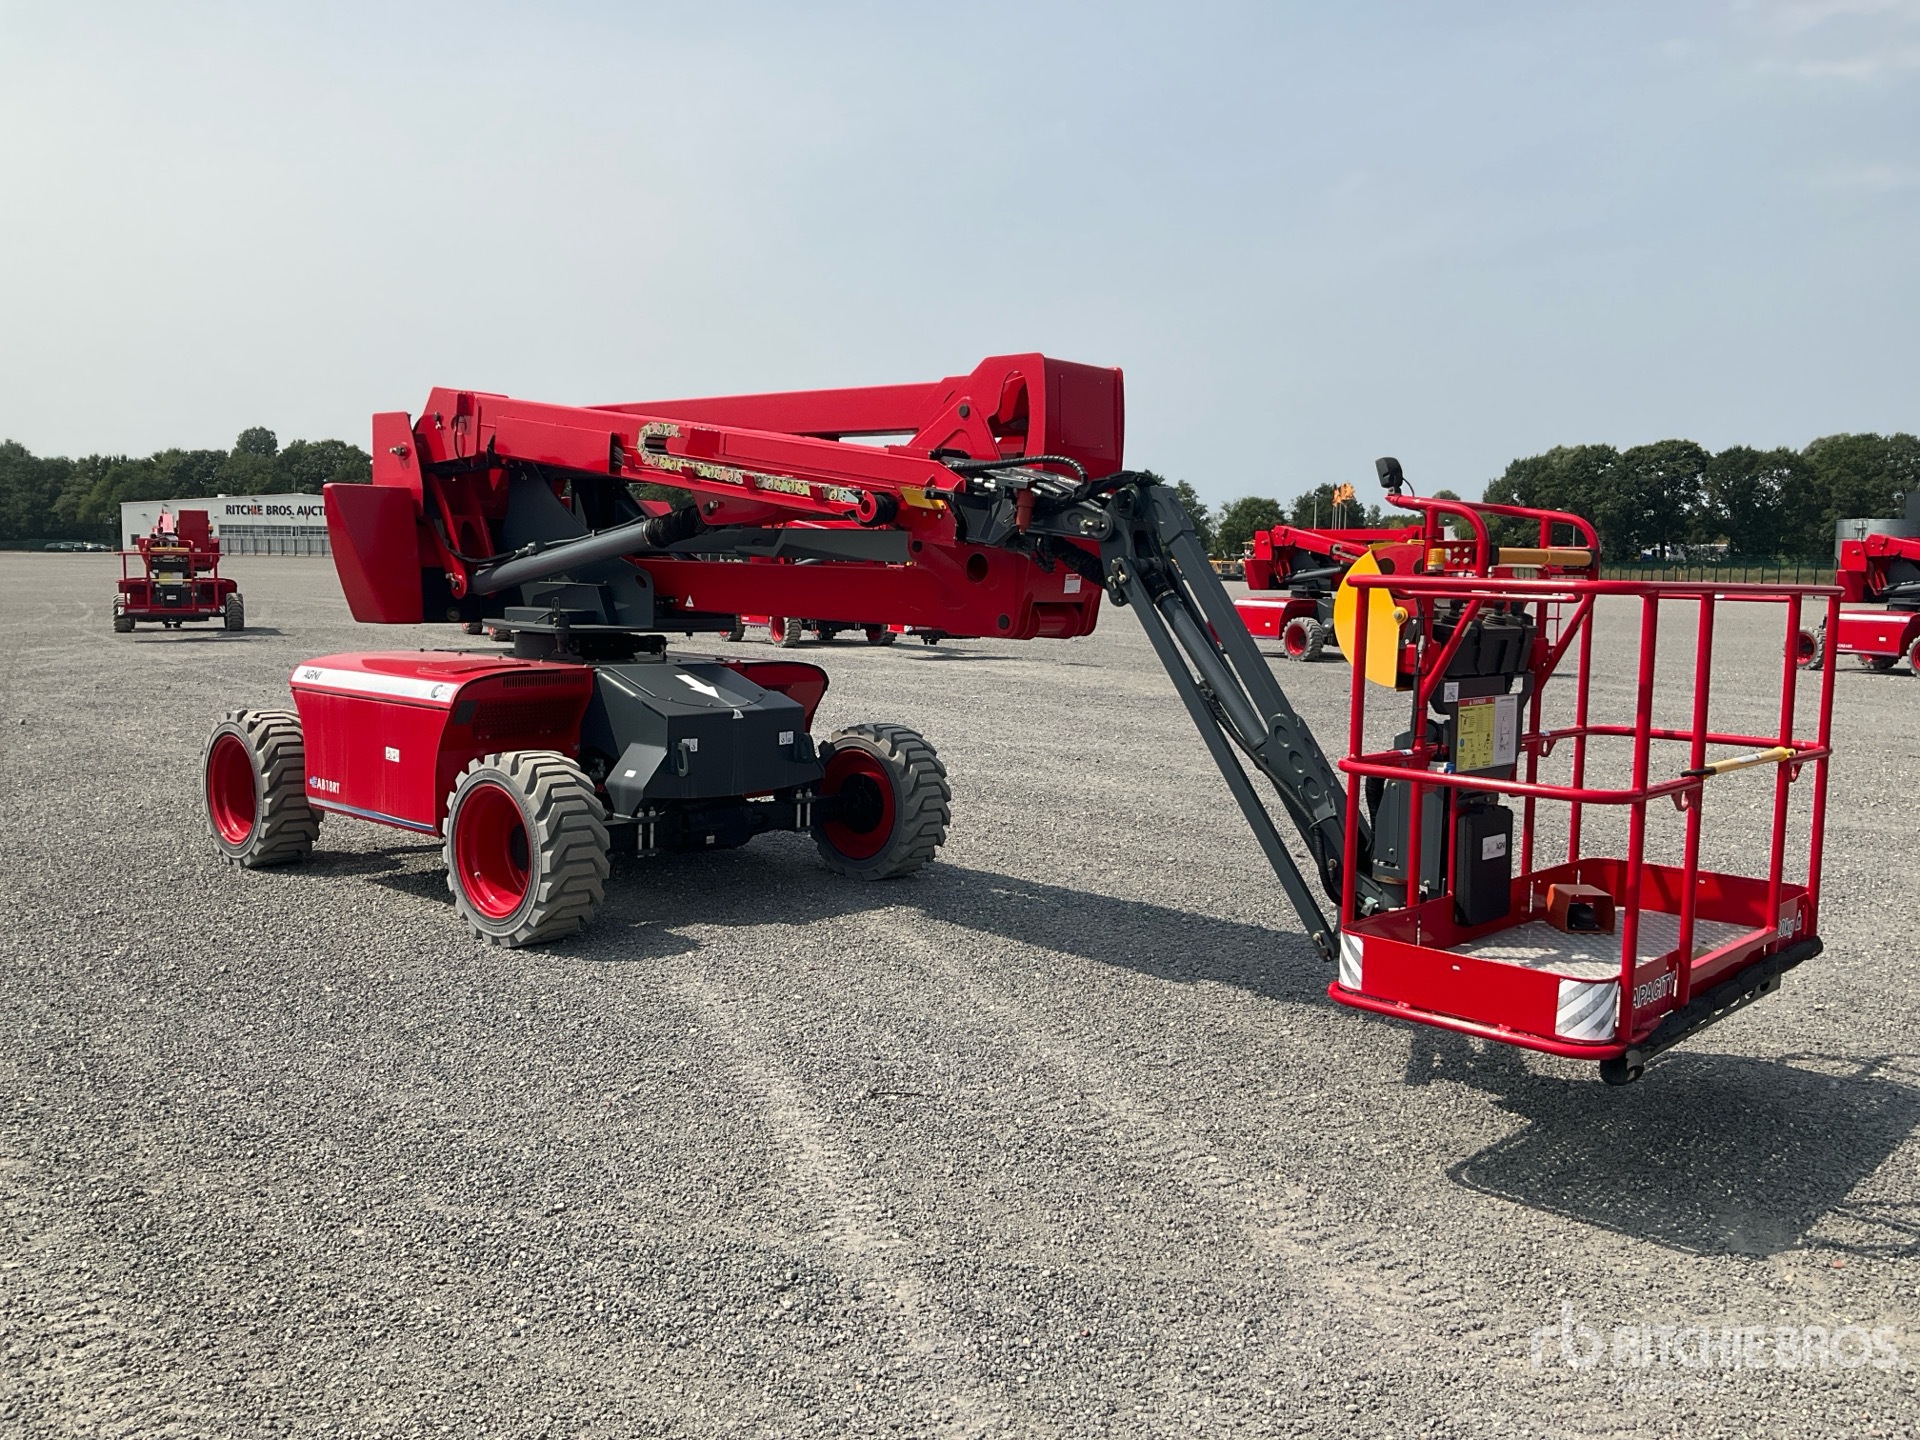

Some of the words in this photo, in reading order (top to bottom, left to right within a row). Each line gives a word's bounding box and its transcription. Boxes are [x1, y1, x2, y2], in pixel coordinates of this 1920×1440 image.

[226, 504, 263, 515] RITCHIE
[266, 505, 294, 515] BROS.
[1633, 970, 1675, 1009] APACITY
